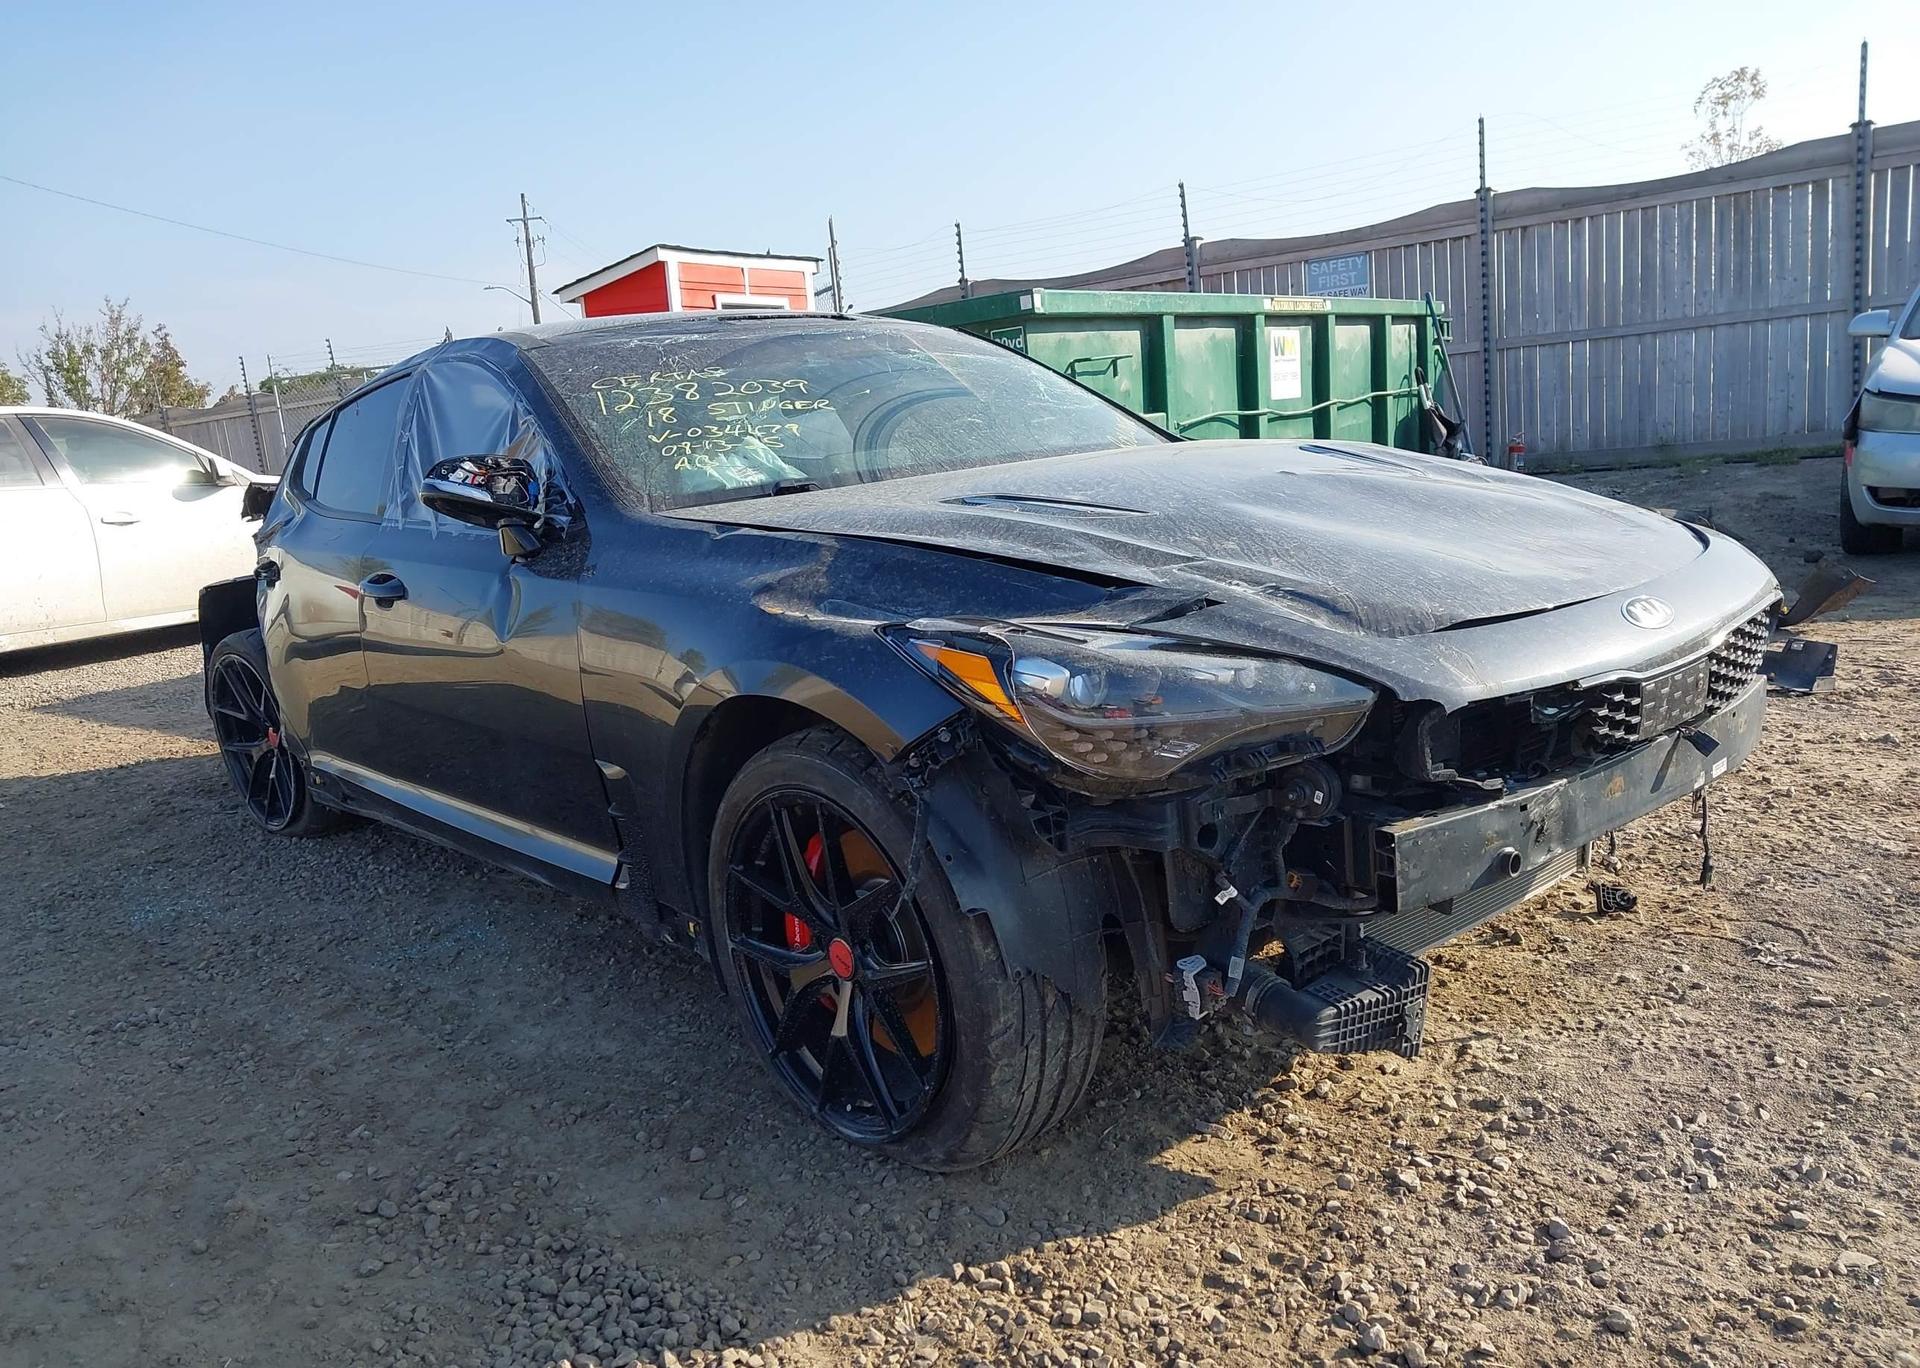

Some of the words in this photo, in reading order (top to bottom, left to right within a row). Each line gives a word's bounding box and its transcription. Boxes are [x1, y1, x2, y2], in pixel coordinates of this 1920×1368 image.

[1310, 255, 1364, 275] SAFETY
[1318, 271, 1358, 289] FIRST
[1350, 286, 1368, 297] WAY
[994, 334, 1023, 349] 0yd
[707, 399, 836, 416] STINGER
